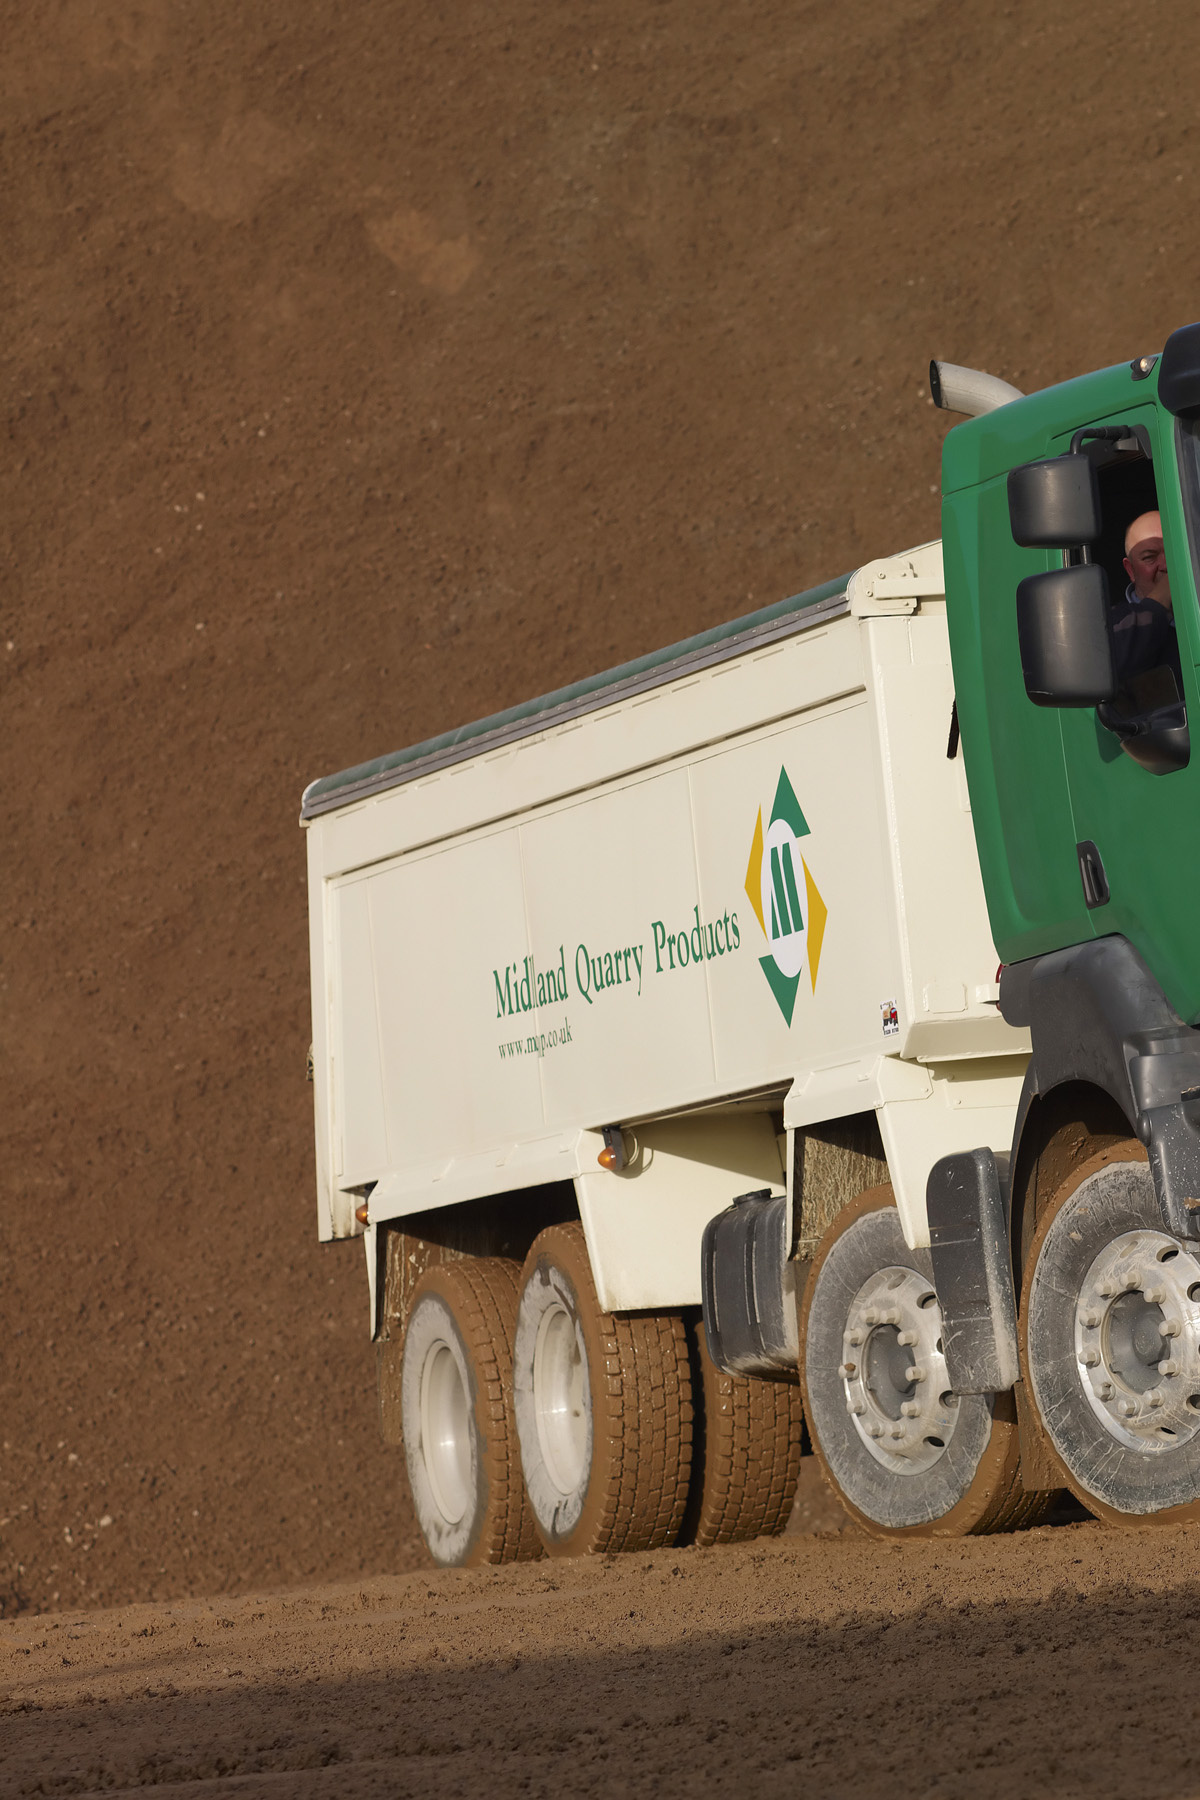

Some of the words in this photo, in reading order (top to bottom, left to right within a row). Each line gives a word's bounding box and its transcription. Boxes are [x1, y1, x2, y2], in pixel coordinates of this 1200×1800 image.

[492, 945, 569, 1019] Midland
[574, 942, 644, 1005] Quarry
[650, 904, 741, 973] Products
